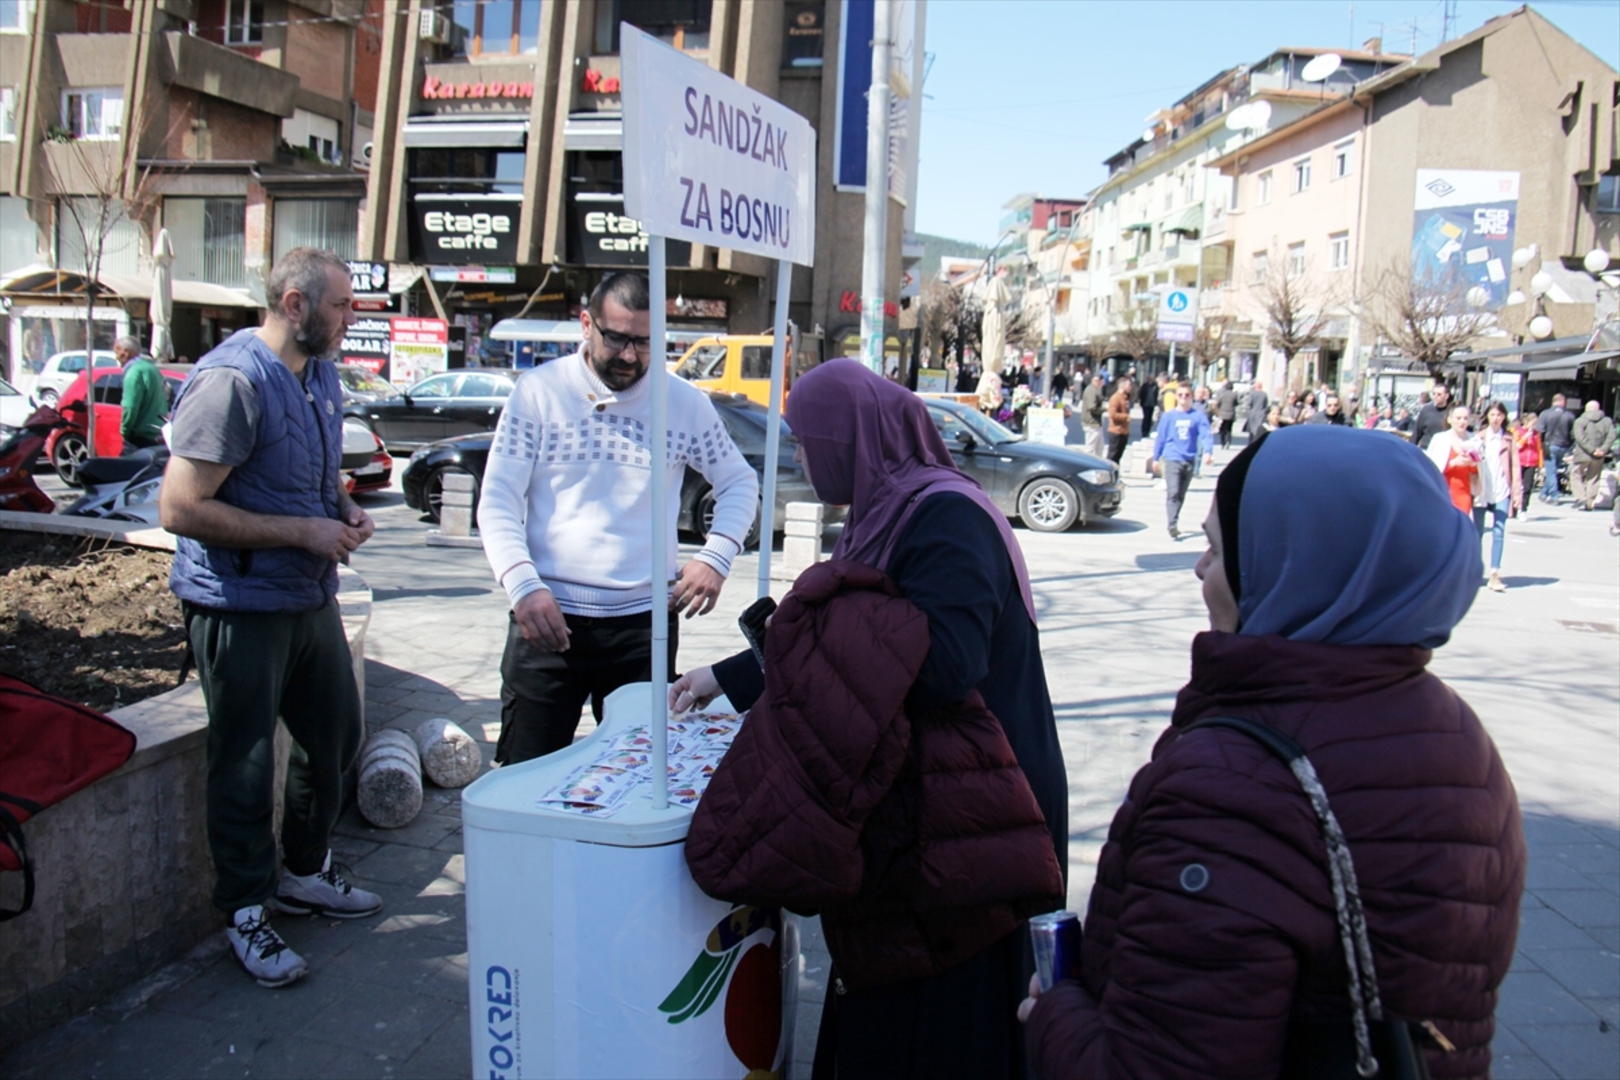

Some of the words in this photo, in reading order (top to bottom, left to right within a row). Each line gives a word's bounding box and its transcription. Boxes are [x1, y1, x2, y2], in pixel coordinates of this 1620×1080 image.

[423, 76, 534, 98] Karavan
[684, 86, 788, 171] SANDŽAK
[424, 211, 510, 235] Etage
[680, 178, 713, 233] ZA
[720, 189, 790, 248] BOSNU
[438, 235, 498, 249] caffe
[599, 236, 649, 251] caff
[341, 339, 381, 352] DOLAR
